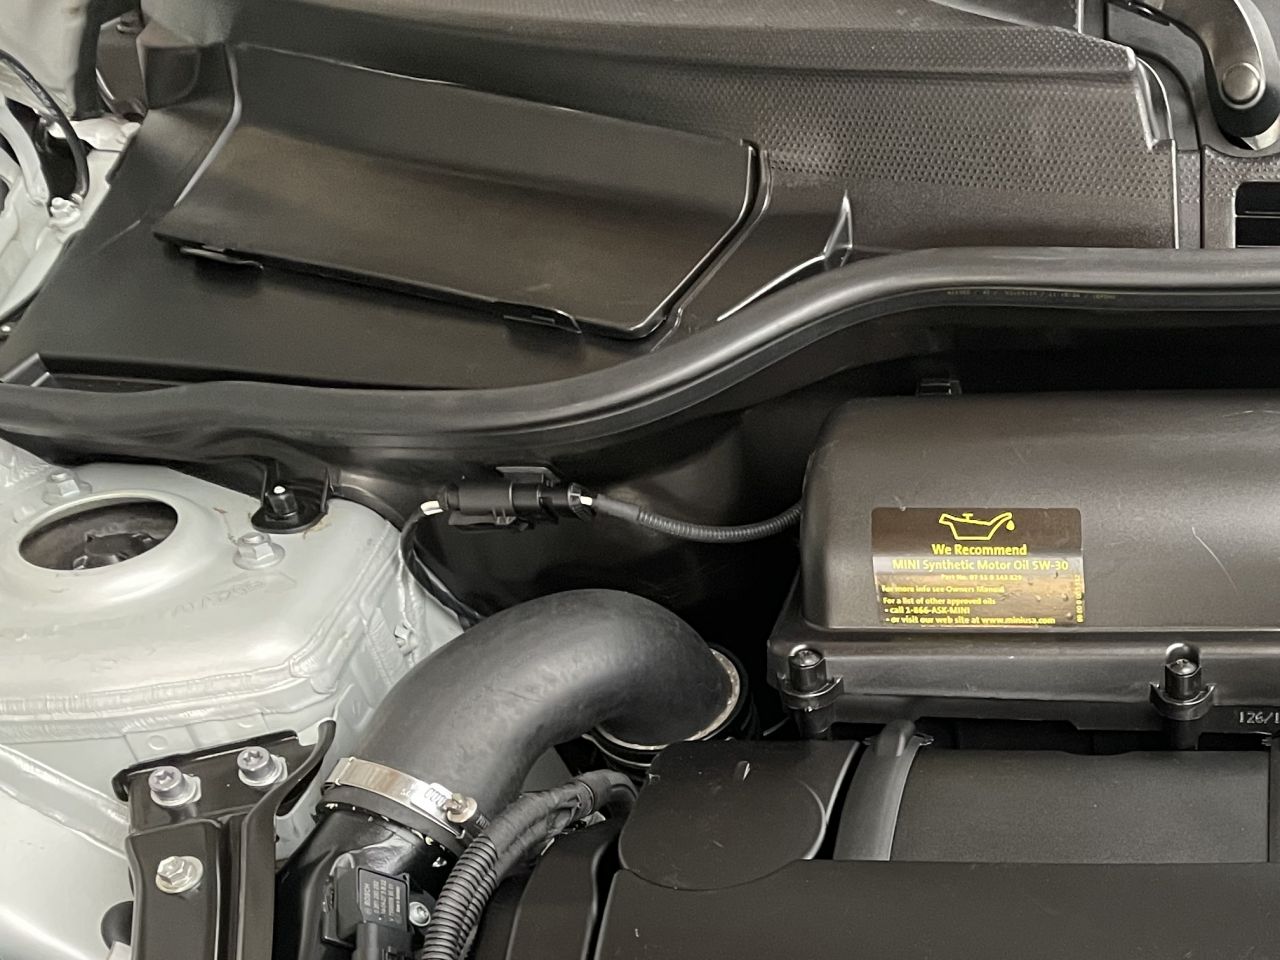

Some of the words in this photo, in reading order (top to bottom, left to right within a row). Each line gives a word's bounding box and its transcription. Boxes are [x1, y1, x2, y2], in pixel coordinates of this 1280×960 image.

[931, 544, 952, 556] We
[955, 544, 1028, 556] Recommend
[892, 560, 920, 570] MINI
[923, 560, 974, 572] Synthetic
[977, 560, 1010, 570] Motor
[1013, 560, 1029, 570] Oil
[1032, 560, 1069, 570] 5W-30
[894, 585, 914, 593] more
[916, 585, 931, 593] info
[932, 585, 945, 593] see
[976, 585, 1005, 593] Manual
[947, 598, 982, 607] approved
[889, 606, 904, 614] call
[890, 616, 900, 624] or
[901, 616, 919, 624] visit
[920, 616, 934, 624] our
[935, 616, 953, 624] web
[954, 616, 969, 624] site
[971, 616, 980, 624] at
[981, 616, 1056, 624] www.miniusa.com
